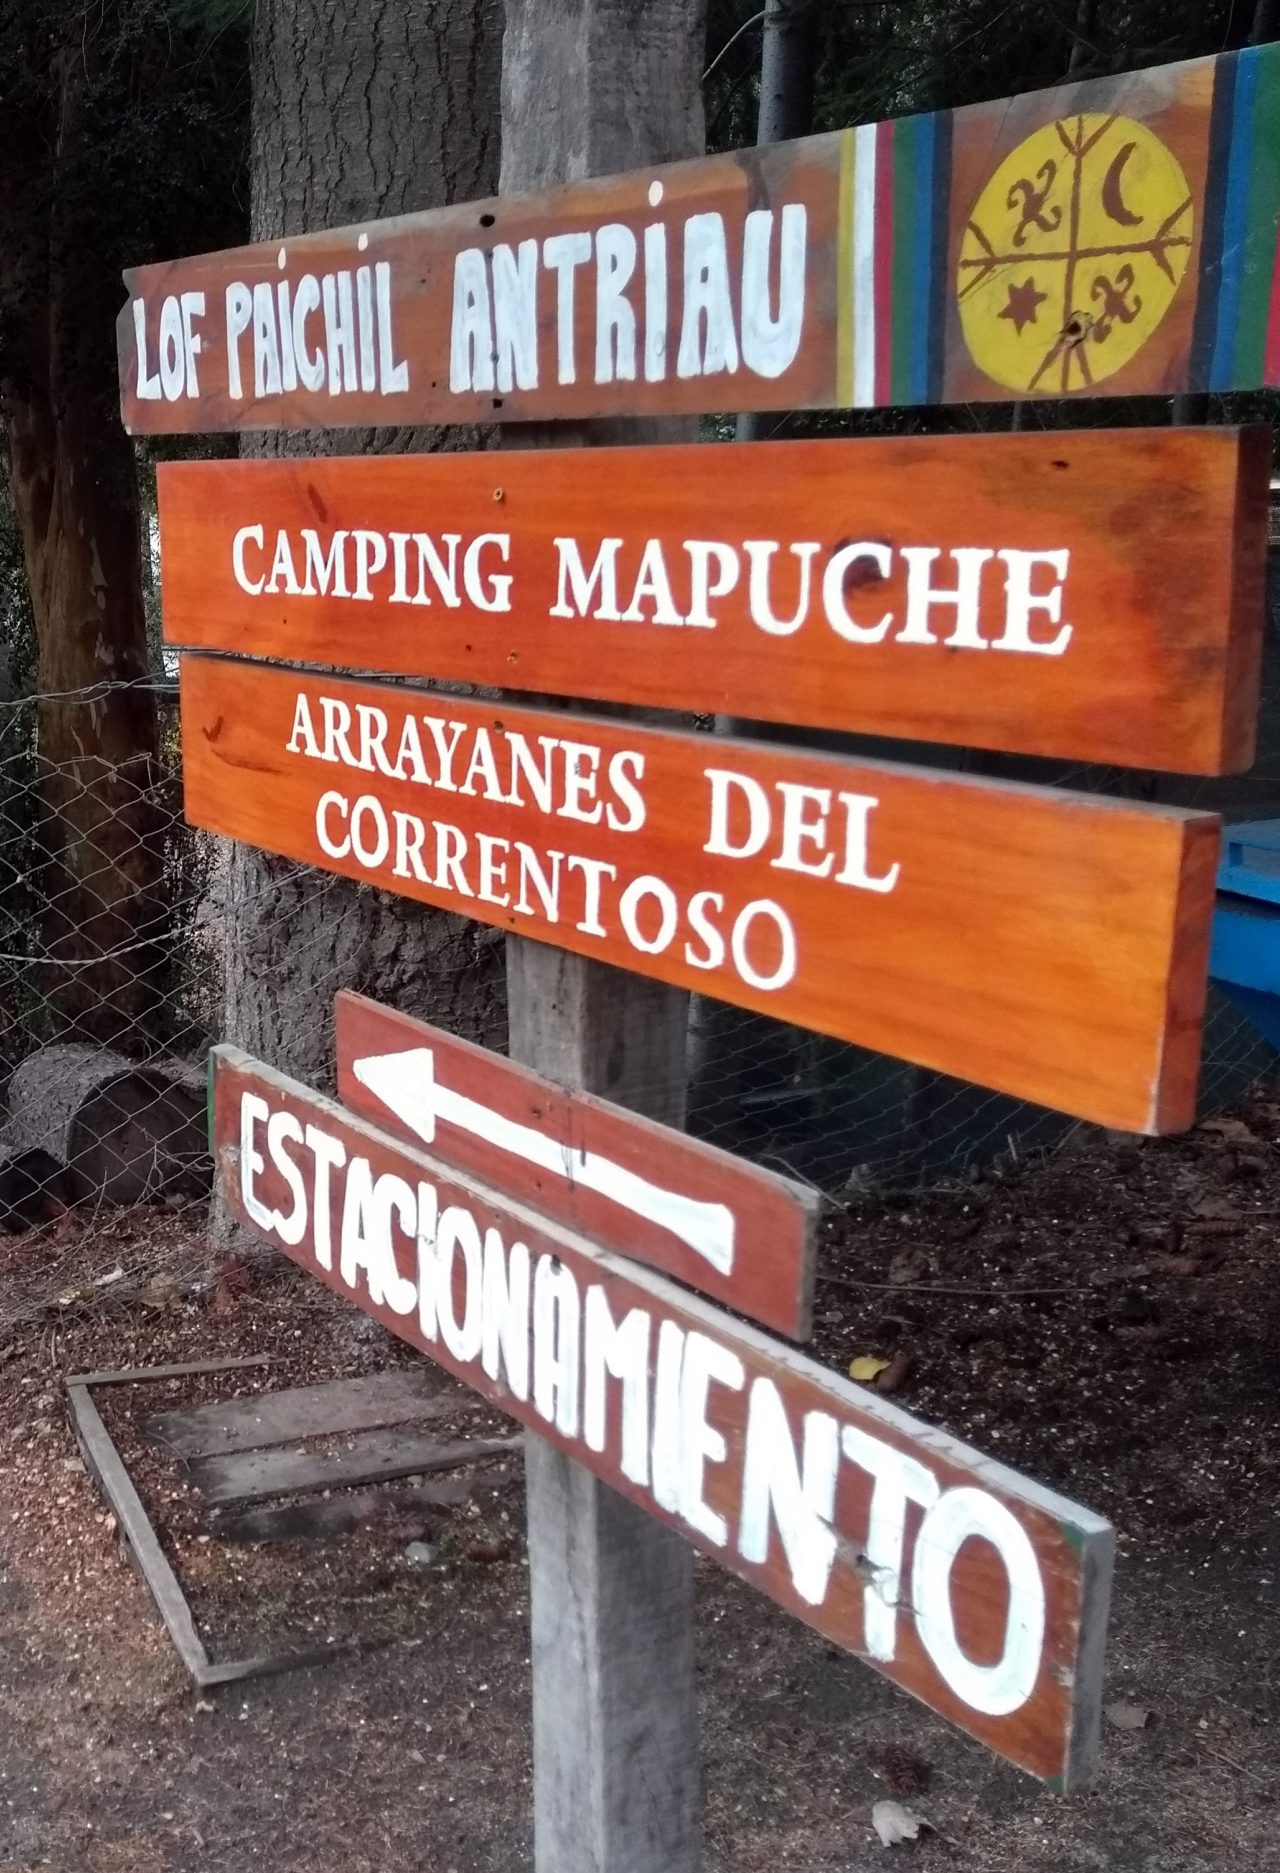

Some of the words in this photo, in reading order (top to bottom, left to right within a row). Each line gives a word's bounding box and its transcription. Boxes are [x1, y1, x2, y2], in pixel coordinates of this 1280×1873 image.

[132, 291, 206, 402] LOF
[231, 523, 513, 613] CAMPING
[549, 536, 1074, 656] MAPUCHE
[285, 692, 647, 833] ARRAYANES
[702, 767, 901, 893] DEL
[314, 789, 798, 991] CORRENTOSO
[239, 1090, 1047, 1717] ESTACIONAMIENTO
